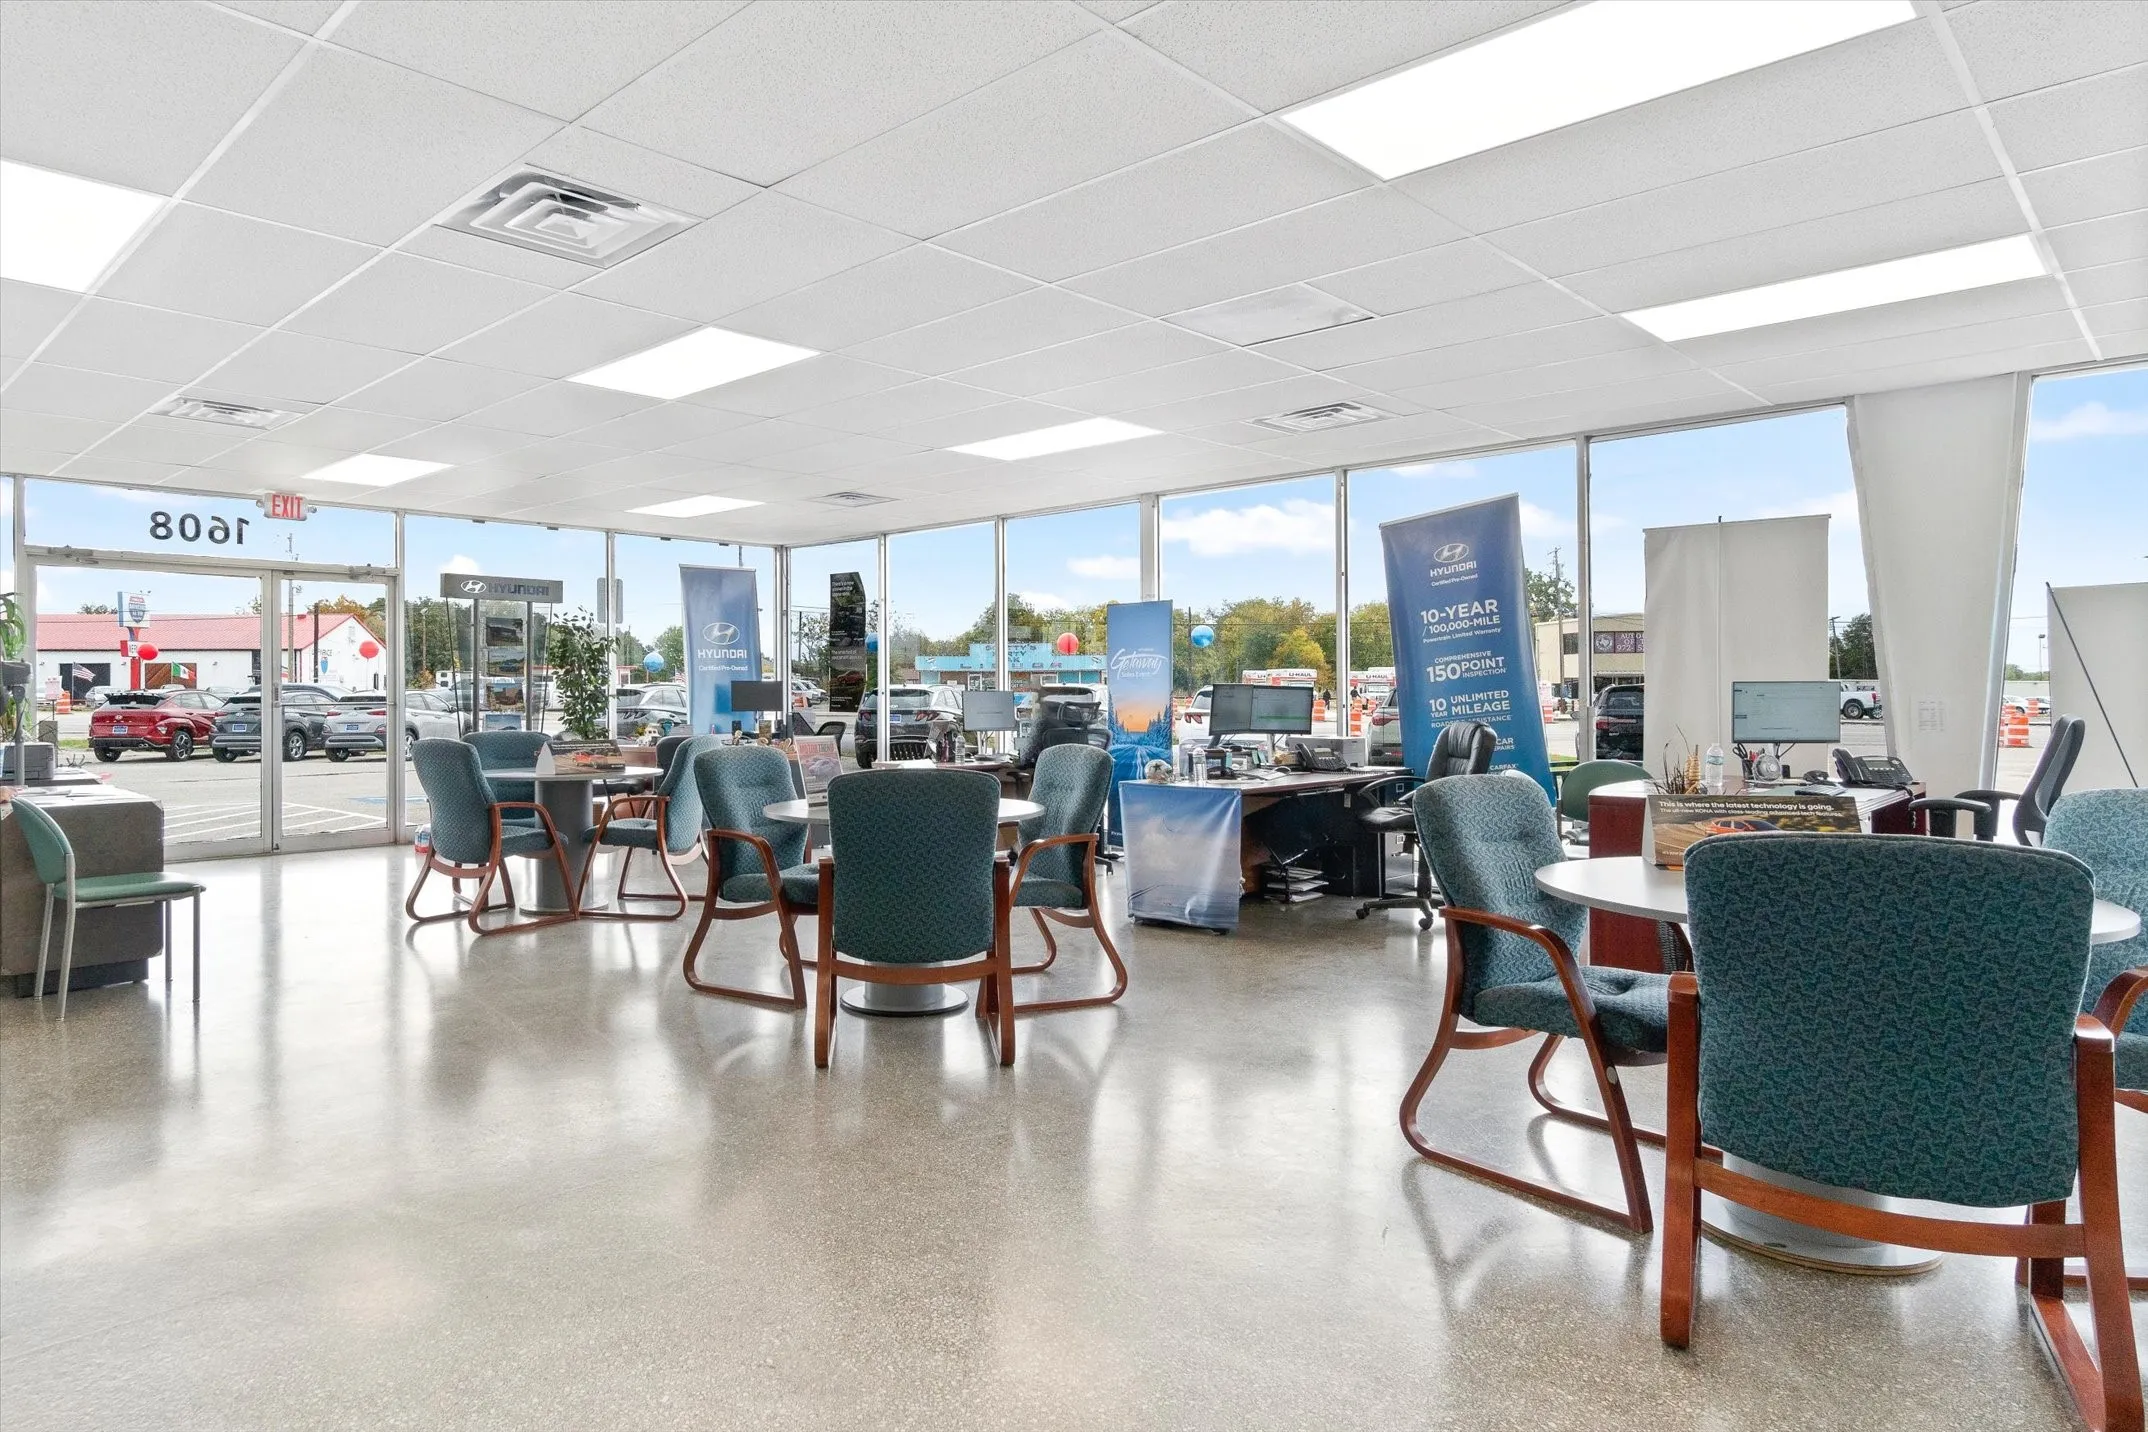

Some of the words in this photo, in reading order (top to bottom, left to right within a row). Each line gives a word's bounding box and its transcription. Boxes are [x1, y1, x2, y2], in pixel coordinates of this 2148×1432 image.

[271, 494, 304, 519] EXIT
[1429, 560, 1477, 578] HYUNDAI
[488, 583, 550, 596] HYUNDAI
[1431, 579, 1451, 587] Certified
[1420, 598, 1499, 625] 10-YEAR
[1428, 614, 1501, 634] 100,000-MILE
[1422, 634, 1451, 644] Powertrain
[1452, 630, 1473, 639] Limited
[1474, 627, 1502, 636] Warranty
[697, 649, 748, 659] HYUNDAI
[1434, 650, 1492, 664] COMPREHENSIVE
[1110, 648, 1168, 680] Getaway
[1426, 663, 1461, 683] 150
[1461, 656, 1505, 672] POINT
[1462, 667, 1507, 678] INSPECTION
[1429, 698, 1447, 712] 10
[1450, 690, 1509, 704] UNLIMITED
[1451, 700, 1511, 716] MILEAGE
[1495, 737, 1514, 746] CAR
[1489, 763, 1517, 771] CARFAX
